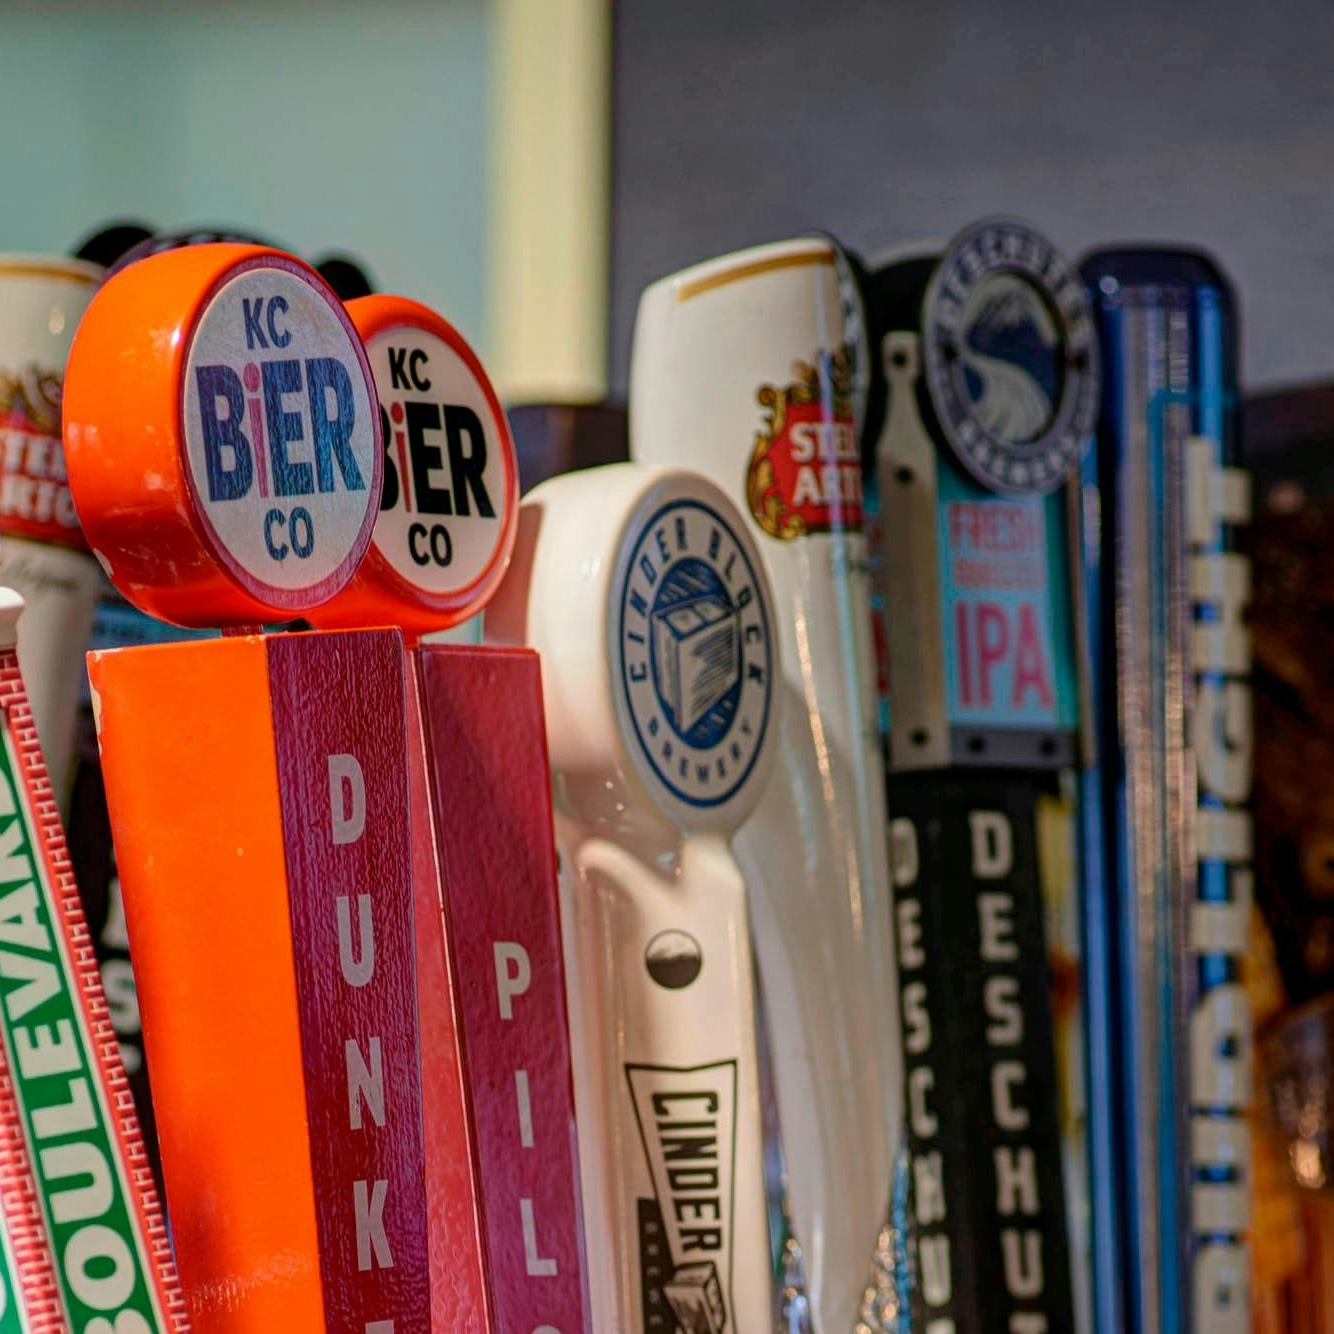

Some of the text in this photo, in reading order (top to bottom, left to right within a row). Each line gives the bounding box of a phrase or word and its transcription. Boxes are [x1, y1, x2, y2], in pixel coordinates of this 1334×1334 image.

[242, 294, 292, 351] KC
[387, 346, 432, 393] KC
[263, 506, 315, 561] CO
[408, 522, 453, 568] CO
[627, 515, 766, 685] CINDER BLOCK
[954, 600, 1057, 712] IPA
[651, 1090, 723, 1255] CINDER
